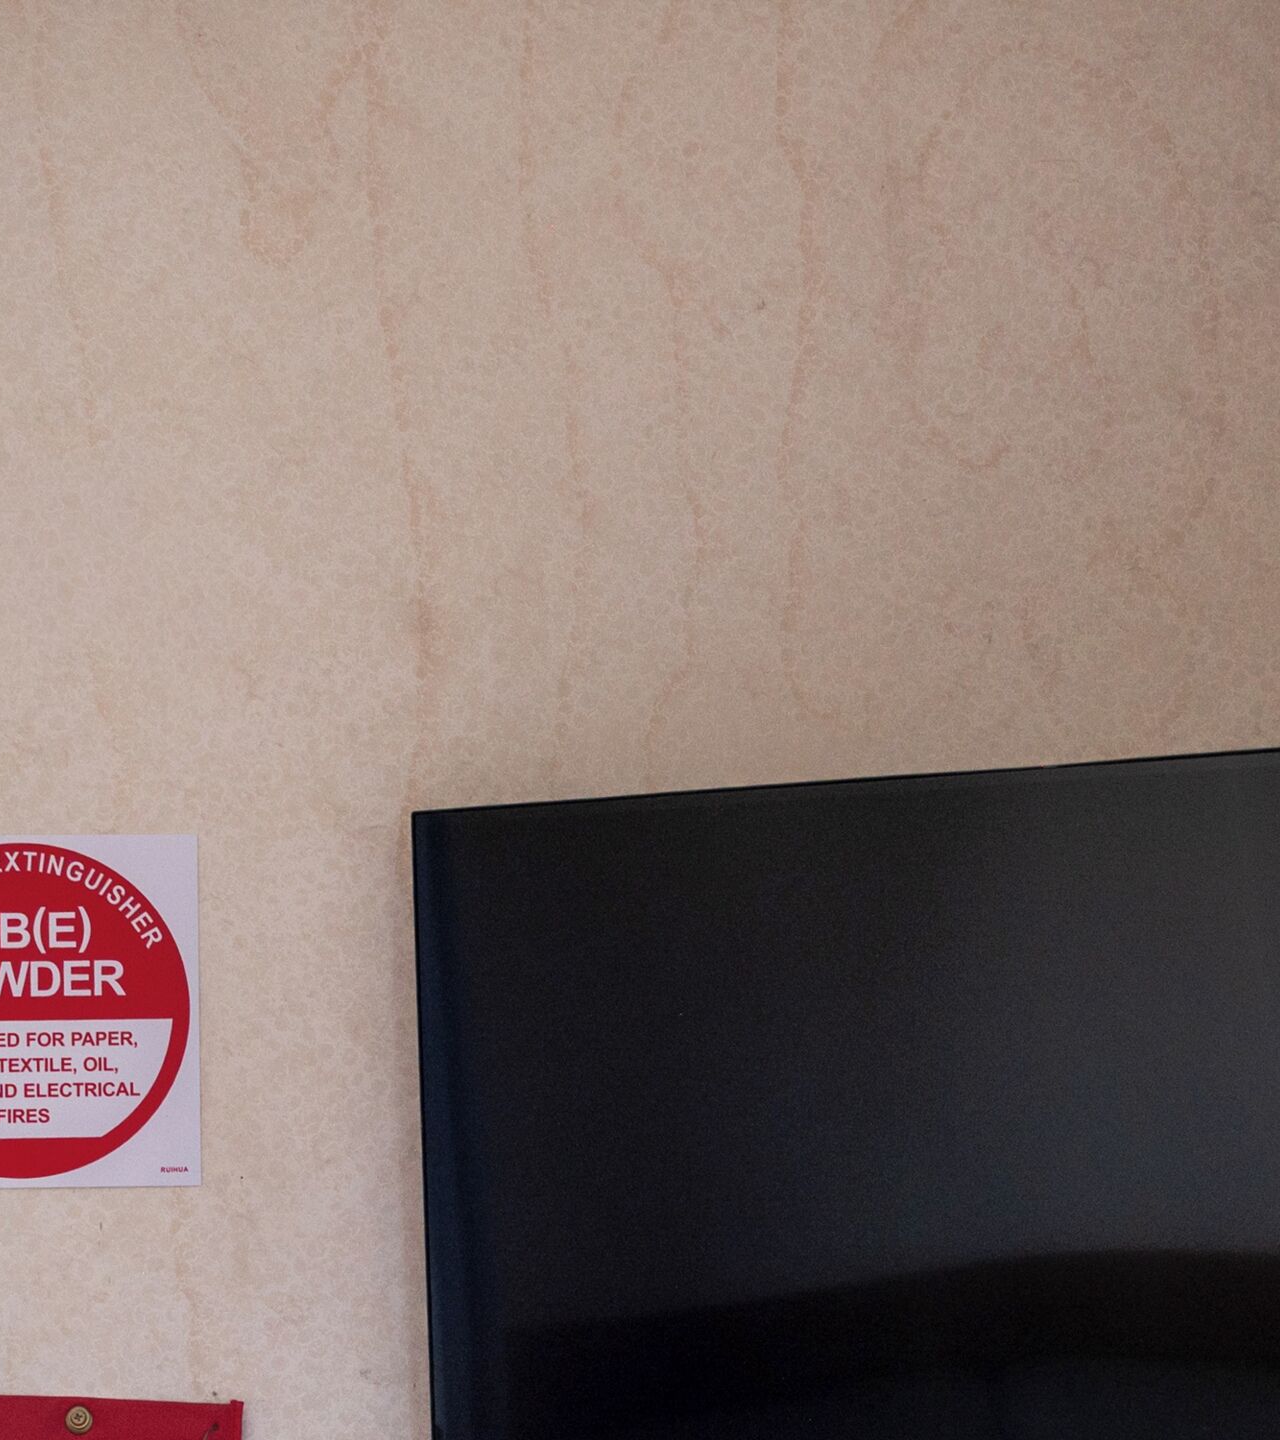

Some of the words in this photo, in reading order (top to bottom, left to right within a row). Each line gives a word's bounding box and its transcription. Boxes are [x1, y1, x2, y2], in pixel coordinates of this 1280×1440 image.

[26, 1032, 64, 1046] FOR
[71, 1031, 138, 1048] PAPER,
[83, 1057, 118, 1073] OIL,
[24, 1082, 140, 1097] ELECTRICAL
